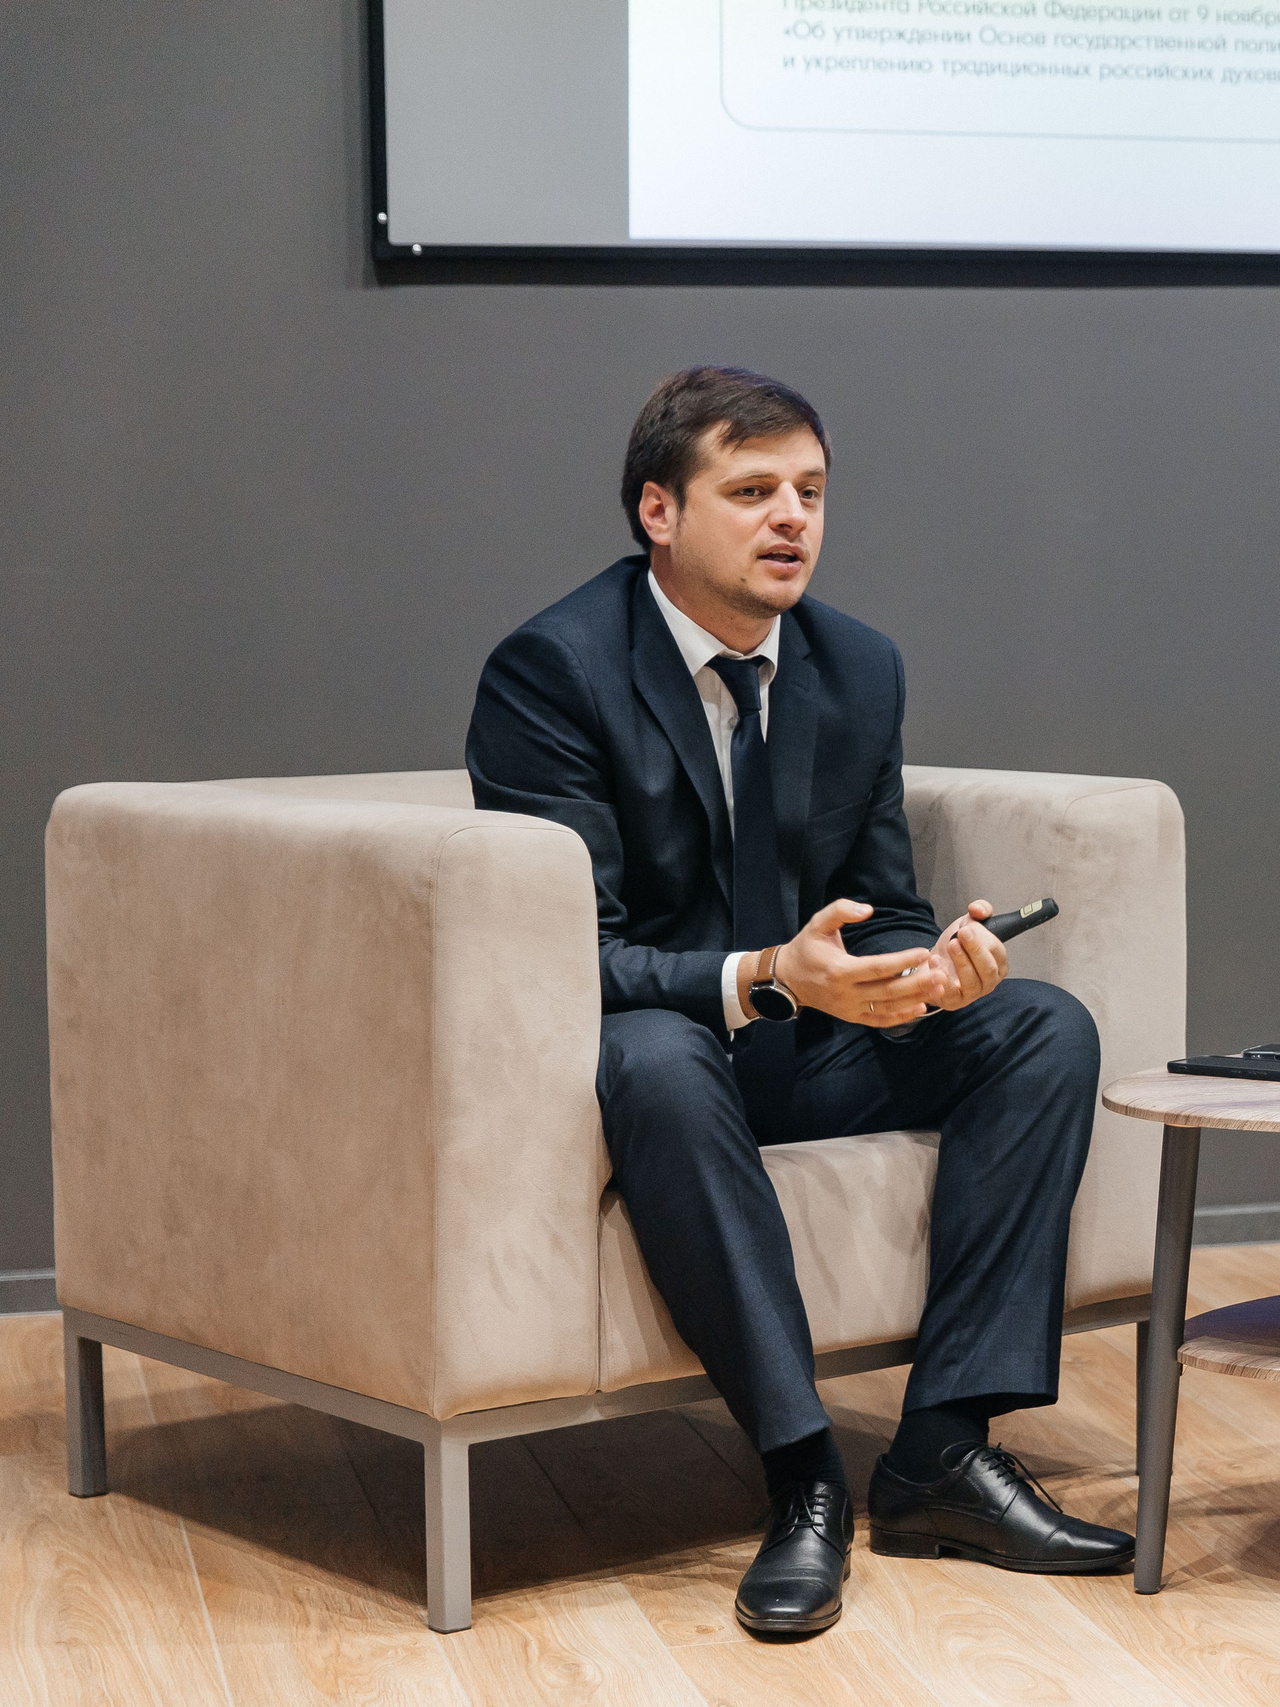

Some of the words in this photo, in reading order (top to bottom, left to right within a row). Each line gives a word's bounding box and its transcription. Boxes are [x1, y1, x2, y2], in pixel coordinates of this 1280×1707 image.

[918, 0, 1036, 18] Российской
[1044, 1, 1161, 23] Федерации
[1169, 7, 1189, 22] от
[1197, 5, 1209, 22] 9
[784, 19, 826, 41] «Об
[833, 26, 971, 45] утверждении
[979, 24, 1046, 46] Основ
[1054, 31, 1227, 52] государственной
[783, 55, 796, 70] и
[802, 55, 934, 74] укреплению
[941, 58, 1090, 78] традиционных
[1099, 62, 1213, 82] российских
